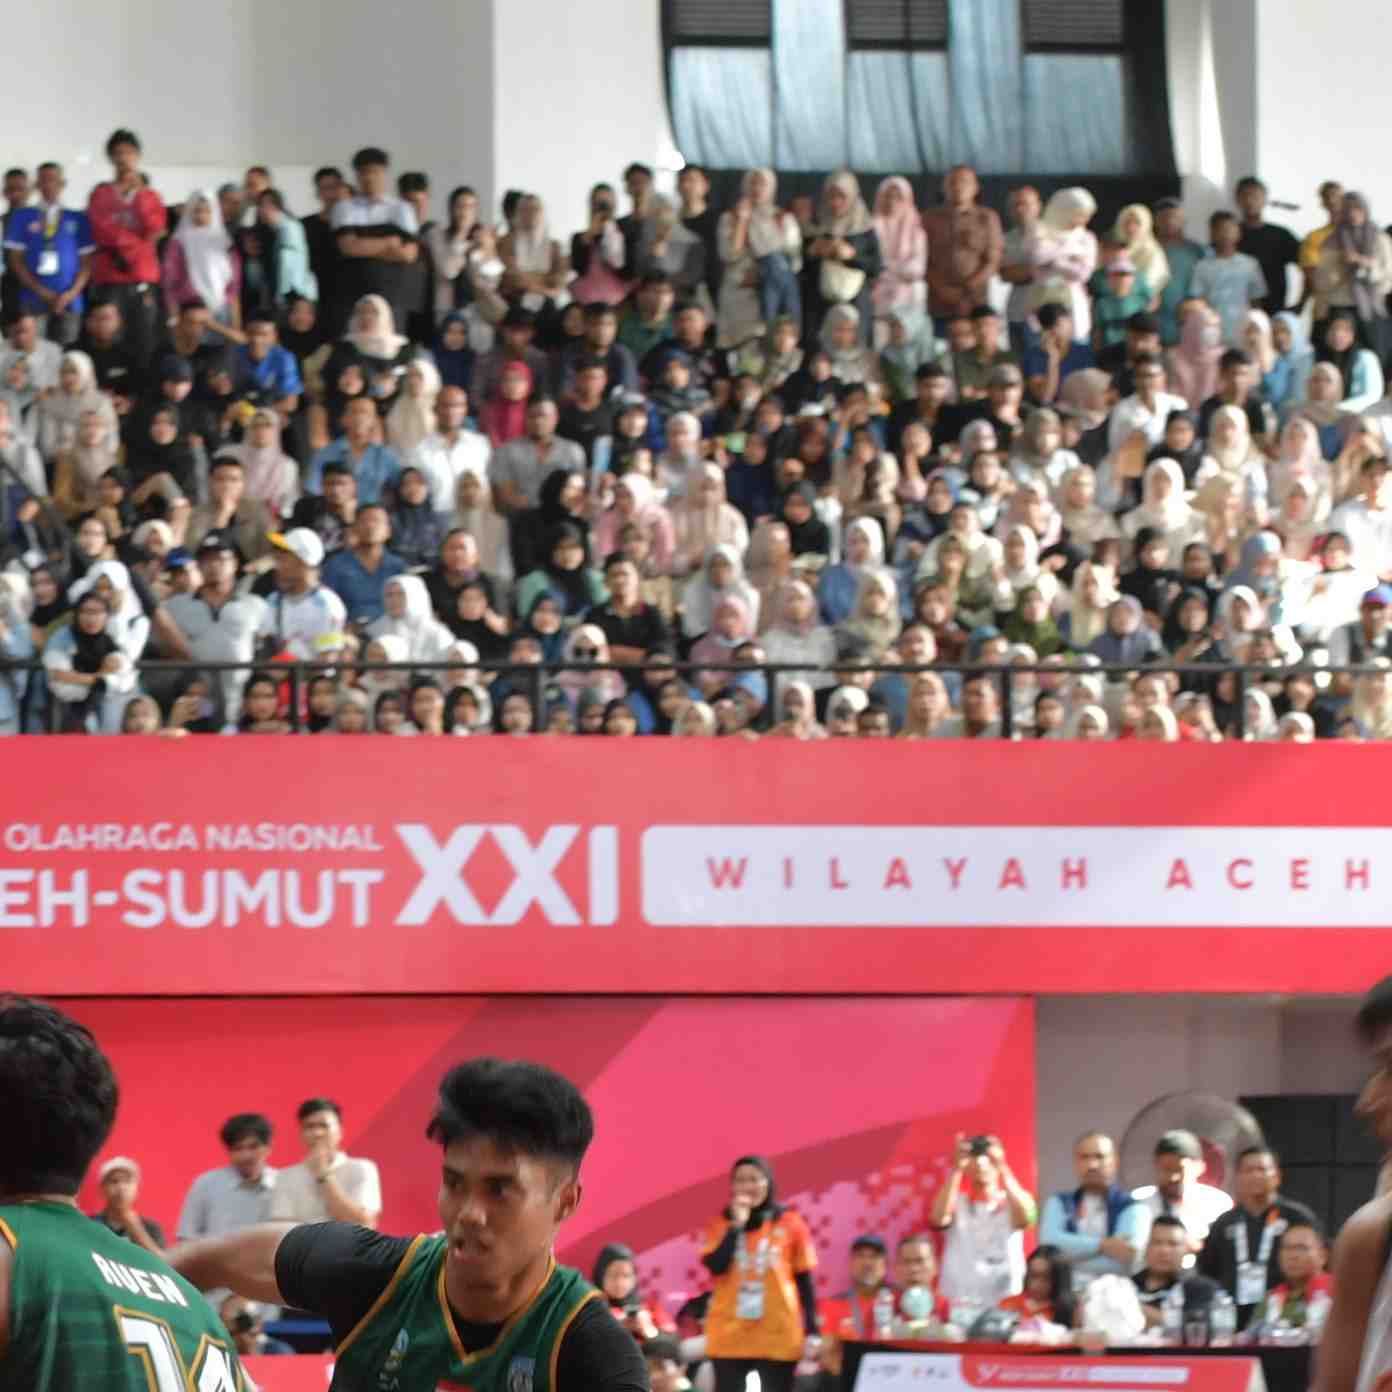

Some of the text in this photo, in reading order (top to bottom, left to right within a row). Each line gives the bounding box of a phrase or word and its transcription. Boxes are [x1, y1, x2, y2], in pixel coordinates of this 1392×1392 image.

[5, 823, 199, 852] OLAHRAGA
[205, 823, 384, 852] NASIONAL
[393, 823, 617, 926] XXI
[705, 857, 1372, 891] WILAYAH ACEH
